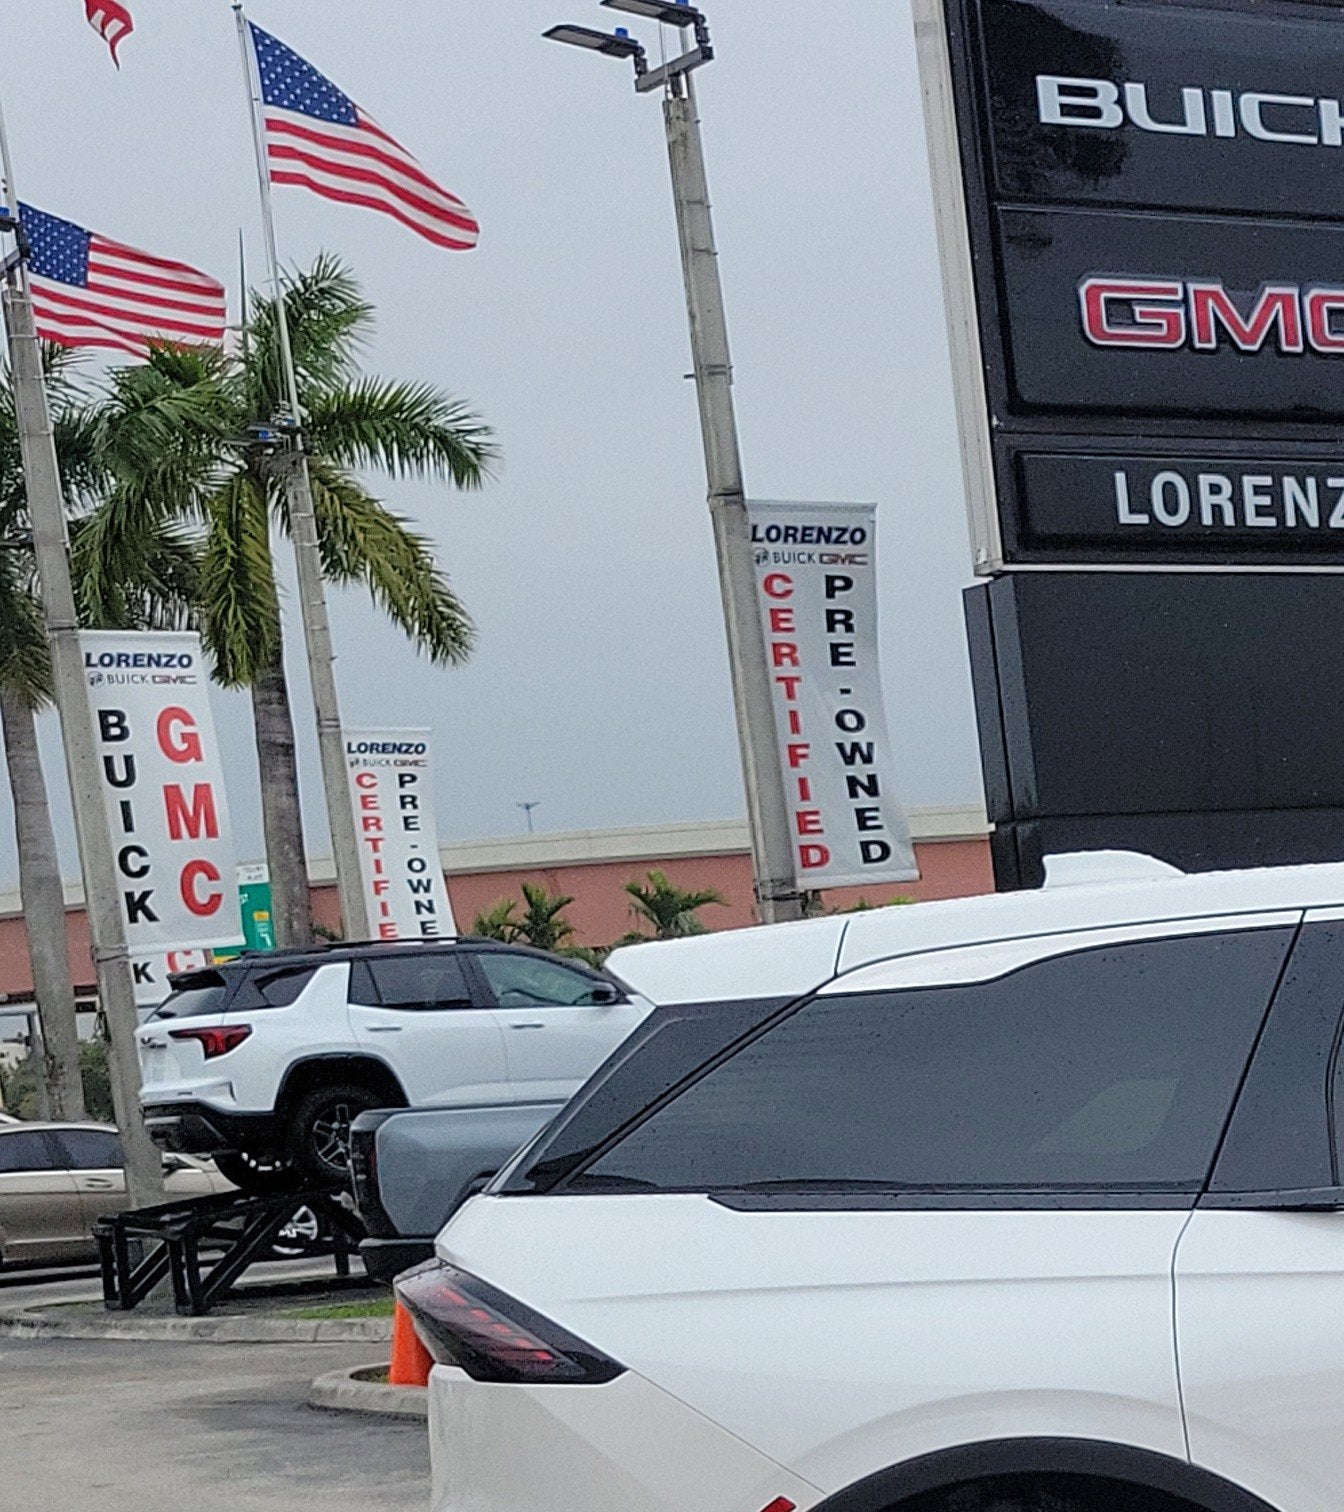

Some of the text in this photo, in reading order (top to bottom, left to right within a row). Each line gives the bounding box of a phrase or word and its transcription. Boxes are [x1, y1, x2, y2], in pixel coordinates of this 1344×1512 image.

[751, 525, 866, 545] LORENZO
[773, 551, 868, 566] BUICK GMC
[85, 652, 192, 668] LORENZO
[107, 674, 197, 685] BUICK GMC
[763, 573, 831, 869] CERTIFIED
[824, 574, 892, 865] PRE-OWNED
[98, 709, 160, 924] BUICK
[157, 706, 223, 917] GMC
[347, 742, 426, 755] LORENZO
[356, 772, 398, 940] CERTIFIE
[398, 773, 439, 936] PRE-OWNE
